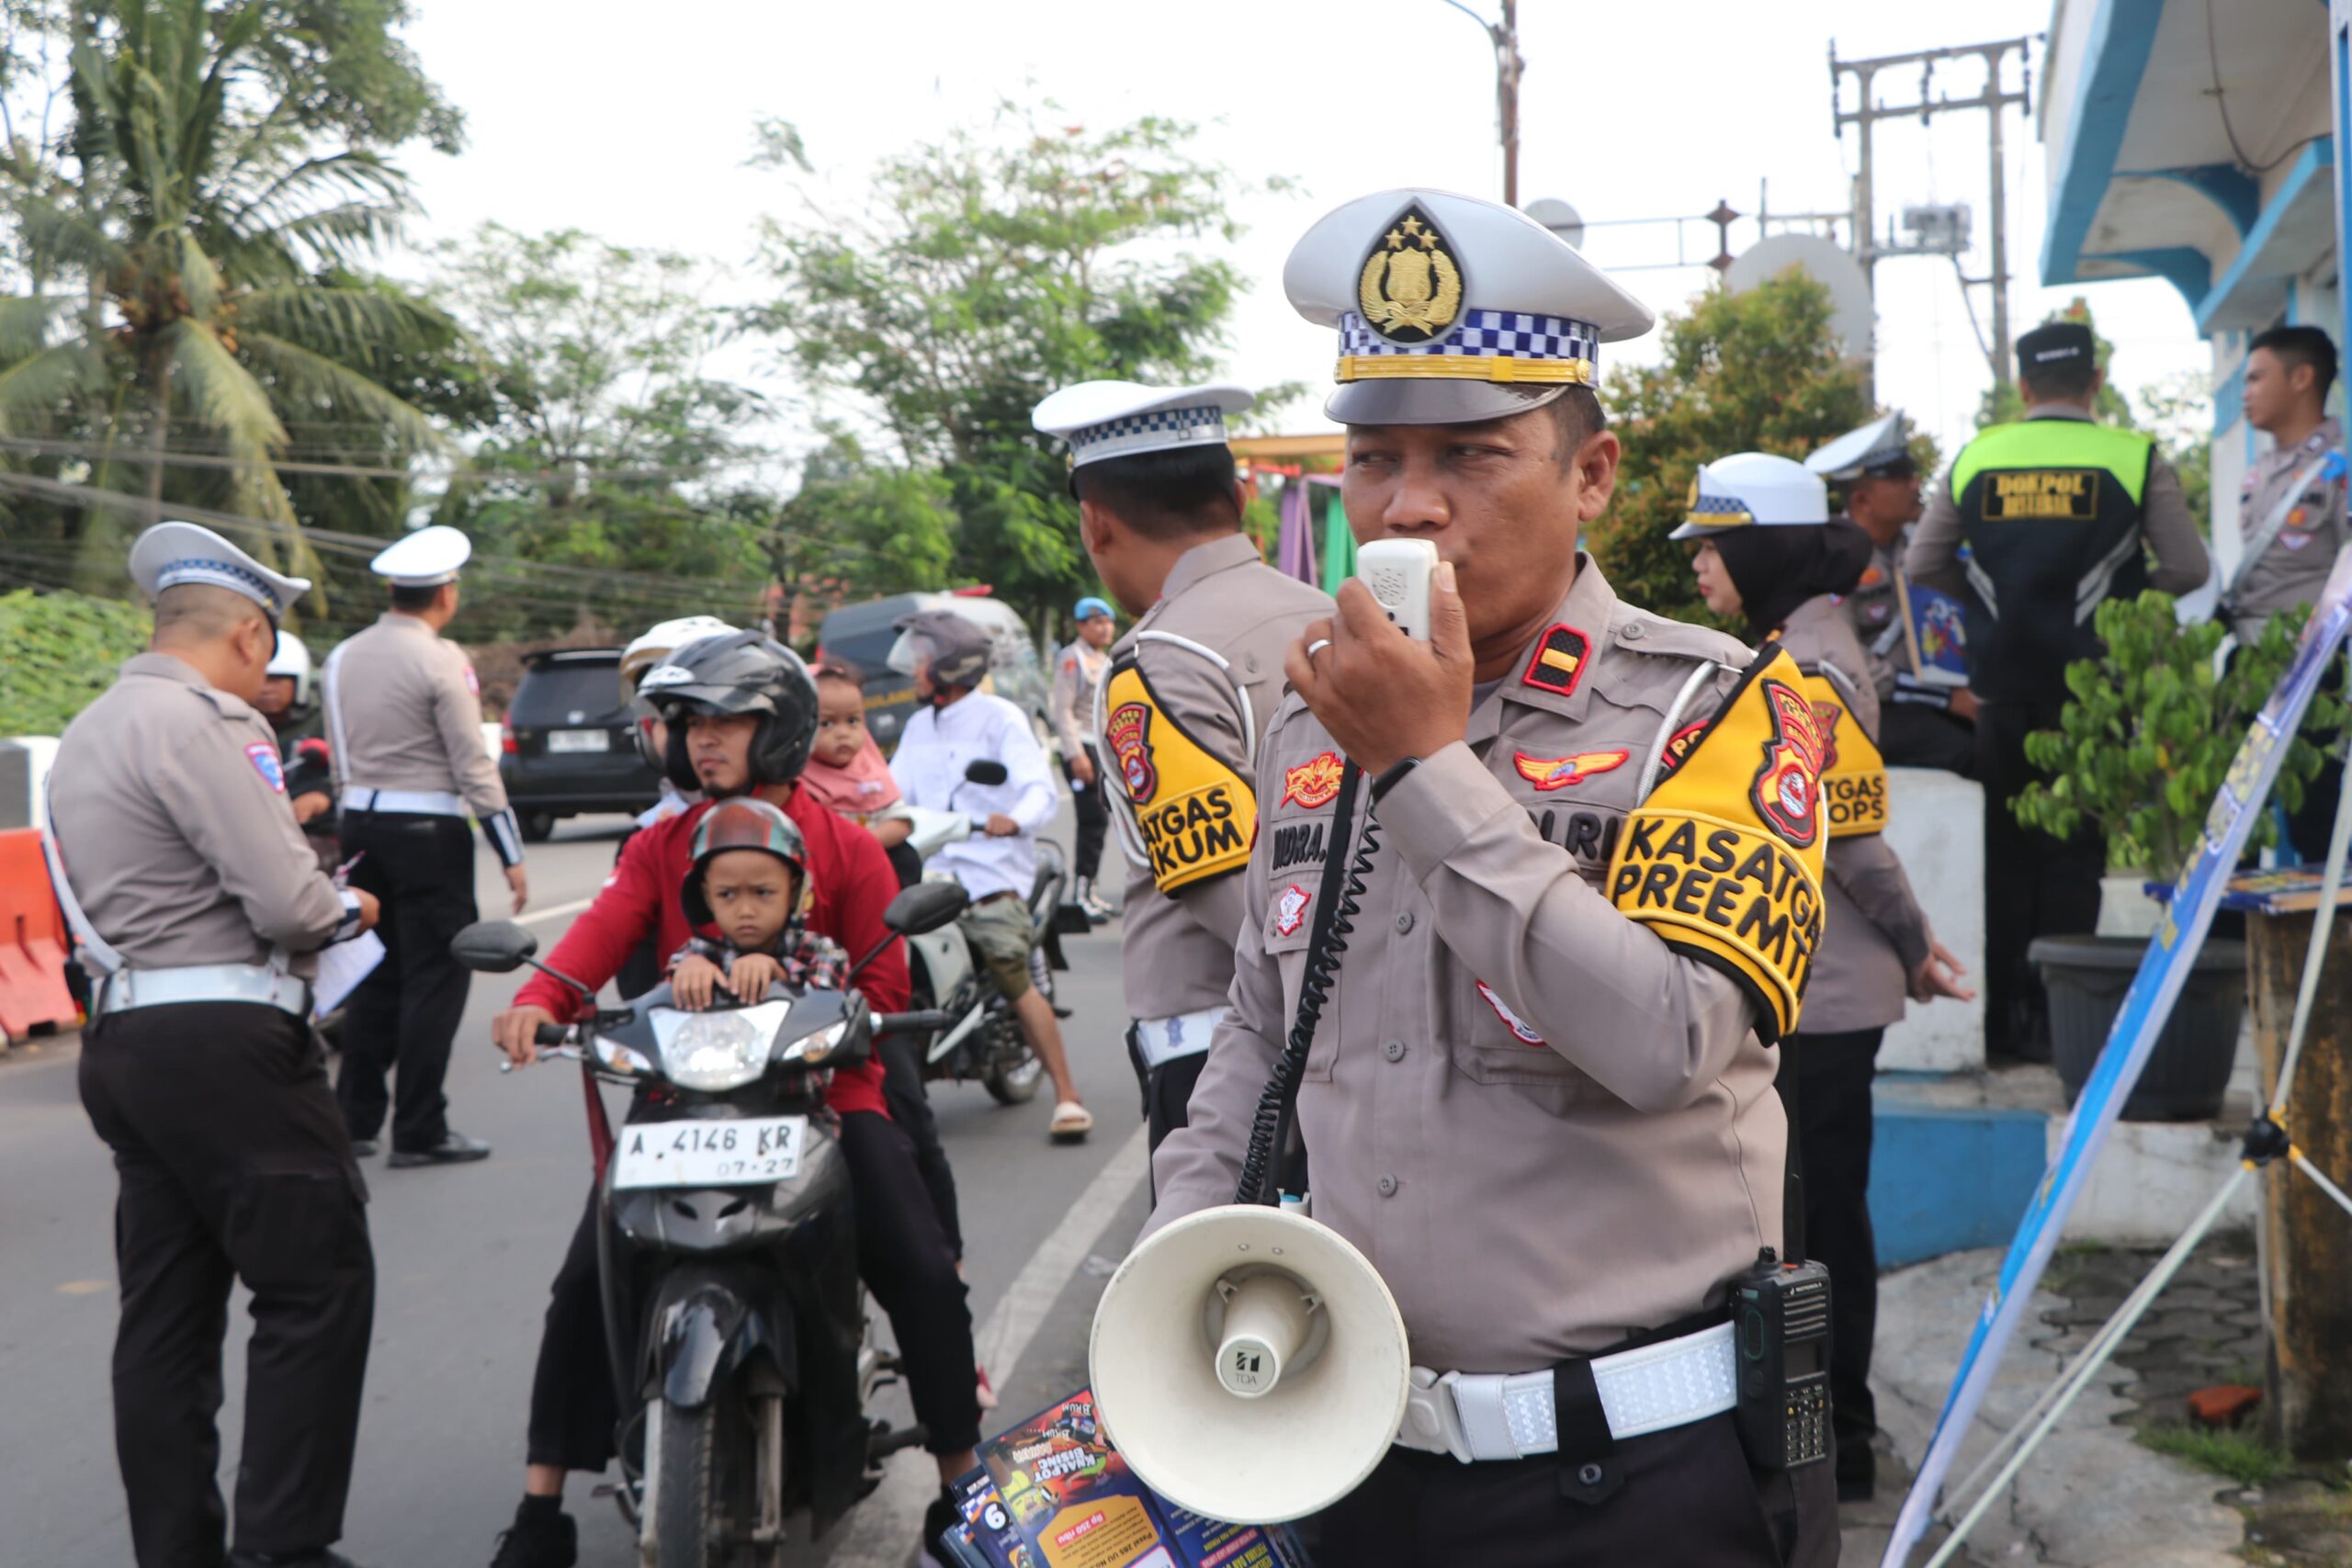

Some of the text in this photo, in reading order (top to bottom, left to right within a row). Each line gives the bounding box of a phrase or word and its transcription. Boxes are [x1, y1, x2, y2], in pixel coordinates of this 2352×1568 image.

[1824, 776, 1884, 801] TGAS
[1141, 788, 1234, 845] ATGAS
[1526, 809, 1619, 863] LRI
[629, 1124, 792, 1156] A 4146 KR
[1035, 1453, 1096, 1483] KNALPOT
[1037, 1447, 1086, 1470] BISING
[1057, 1513, 1104, 1544] Rp 250 ribu
[1134, 1532, 1153, 1548] Pasal
[1108, 1552, 1120, 1563] UU
